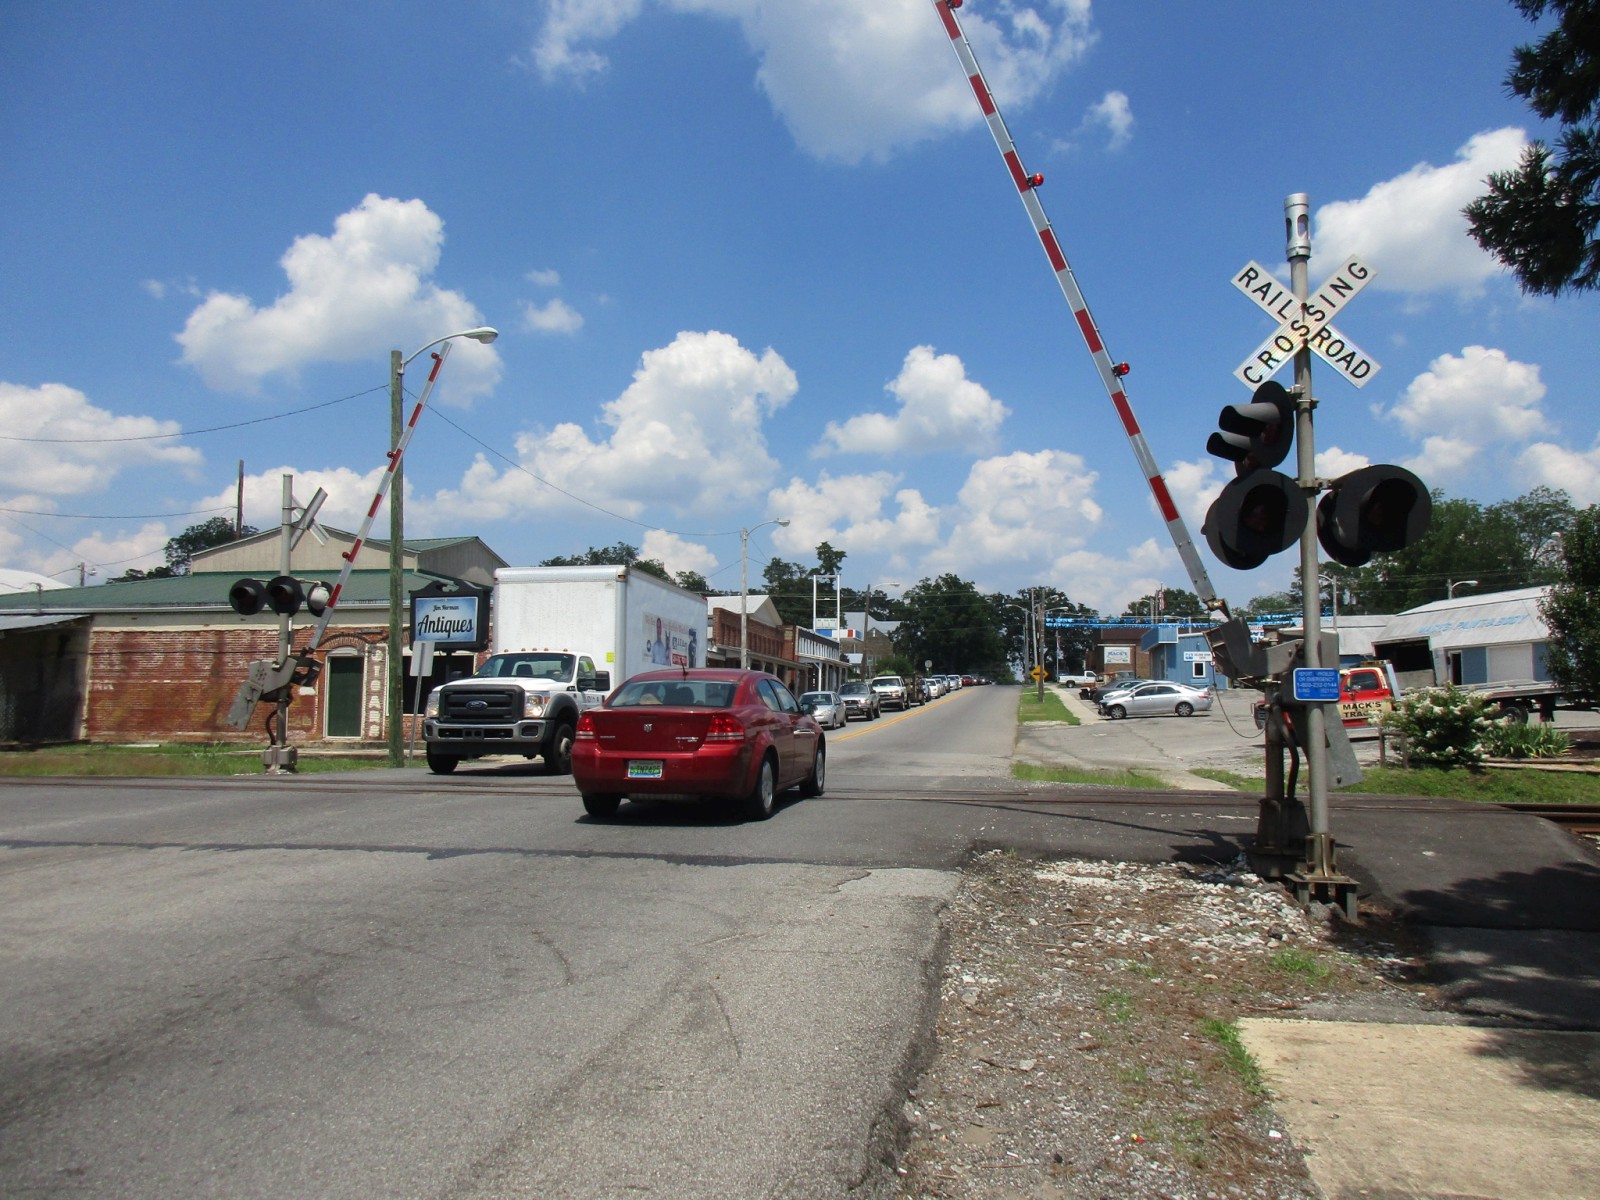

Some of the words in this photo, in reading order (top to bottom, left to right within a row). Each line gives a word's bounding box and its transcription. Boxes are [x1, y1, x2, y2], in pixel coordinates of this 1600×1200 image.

[1238, 267, 1293, 320] RAIL
[1312, 326, 1371, 379] ROAD
[1243, 262, 1368, 384] CROSSING
[417, 614, 474, 639] Antiques
[1343, 701, 1382, 711] MACK'S
